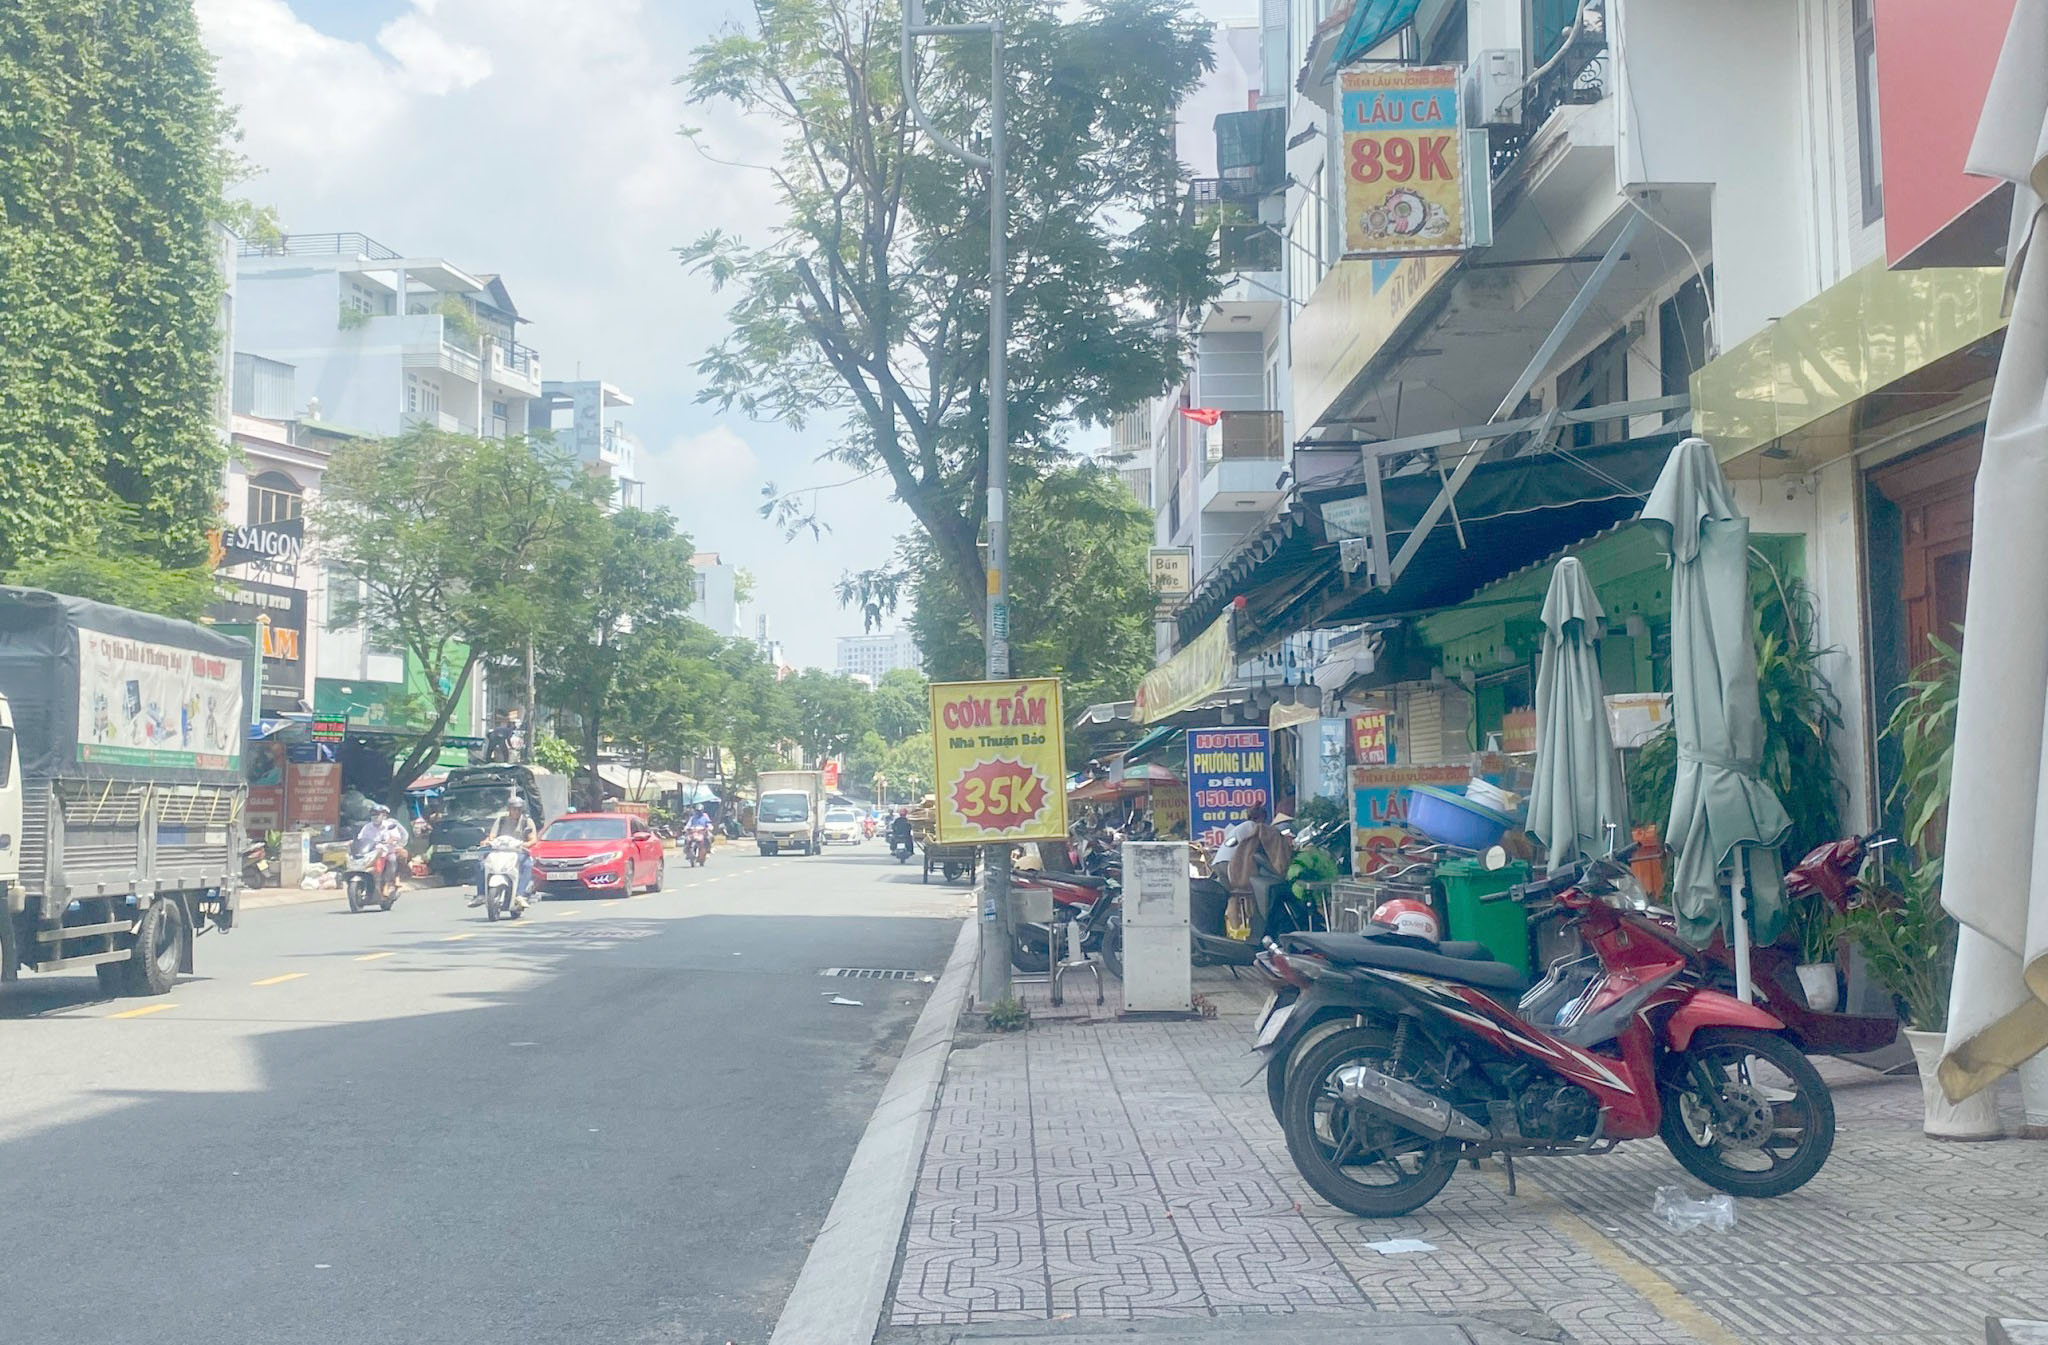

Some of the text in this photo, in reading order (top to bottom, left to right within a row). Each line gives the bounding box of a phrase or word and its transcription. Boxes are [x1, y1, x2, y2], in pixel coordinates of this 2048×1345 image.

[1358, 93, 1442, 124] LẨU CÁ
[1350, 136, 1454, 184] 89K
[236, 525, 304, 560] SAIGON
[943, 685, 1047, 730] CƠM TẤM
[978, 734, 1018, 749] Thuận
[1021, 732, 1046, 747] Bảo
[1196, 733, 1264, 749] HOTEL
[1241, 751, 1264, 773] LAN
[1207, 776, 1253, 787] ĐÊM
[961, 774, 1037, 817] 35K
[1195, 788, 1266, 808] 150.000
[1203, 809, 1226, 821] GIỜ
